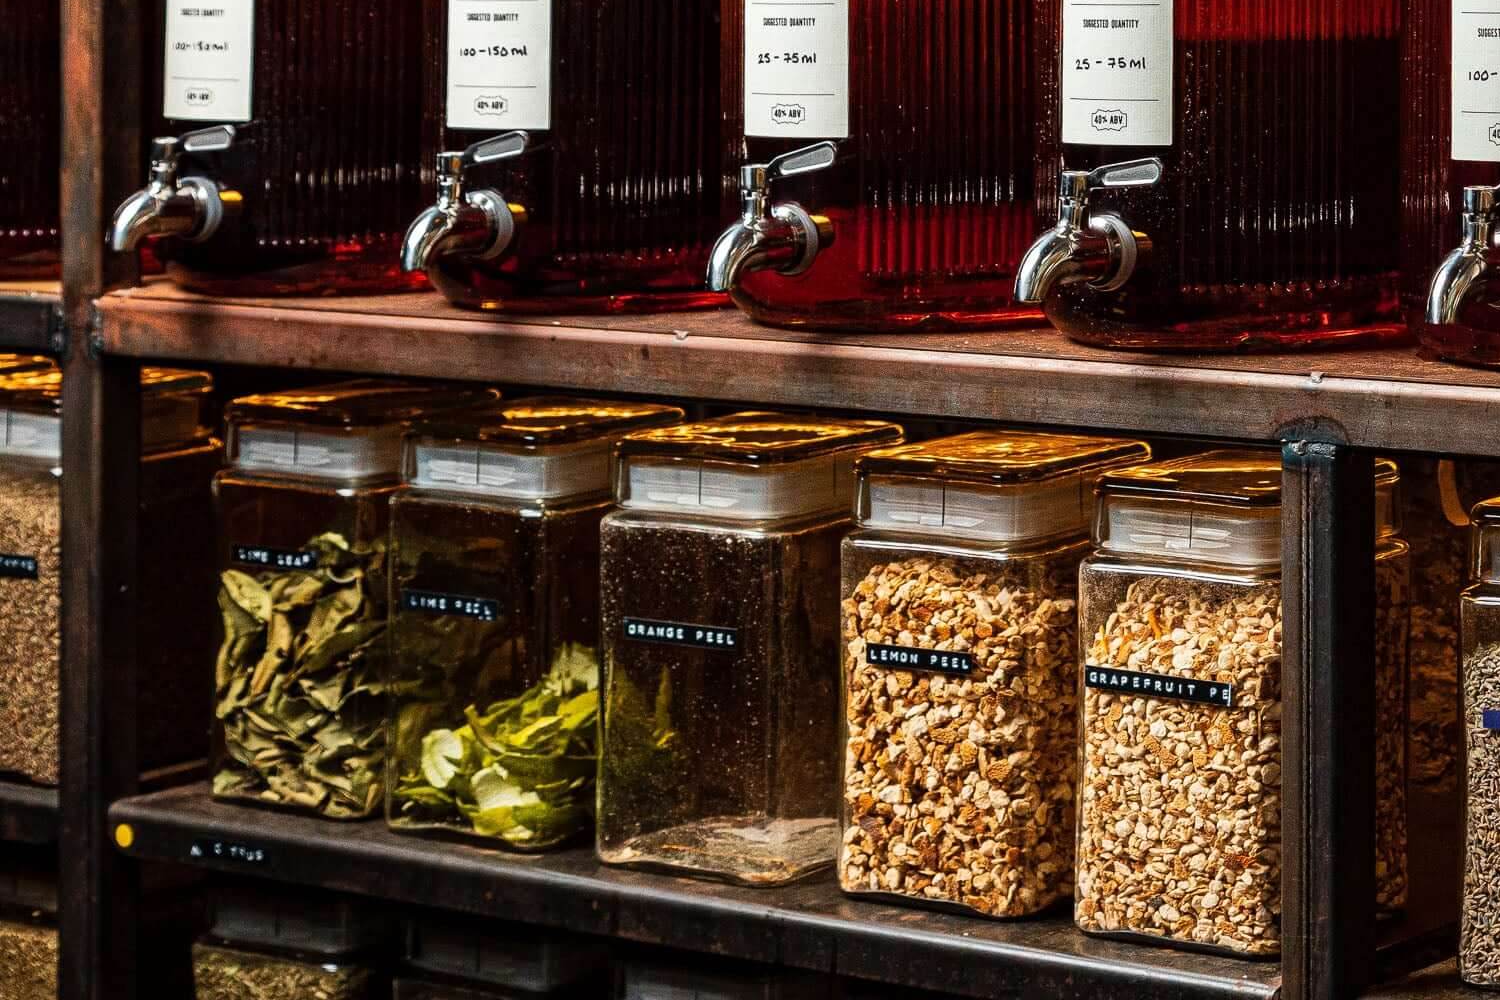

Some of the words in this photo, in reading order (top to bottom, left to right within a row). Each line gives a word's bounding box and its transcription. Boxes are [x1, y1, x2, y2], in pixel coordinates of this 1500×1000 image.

[763, 17, 787, 26] SUGGESTED
[790, 17, 816, 27] QUANTITY
[1083, 19, 1109, 28] SUGGESTED
[1111, 19, 1139, 28] QUANTITY
[774, 109, 786, 118] 40%
[788, 109, 801, 118] ABV
[1109, 115, 1123, 124] ABV
[628, 624, 683, 639] ORANGE
[696, 631, 735, 645] PEEL
[870, 650, 919, 664] LEMON
[930, 655, 969, 669] PEEL
[1089, 671, 1196, 695] GRAPEFRUIT
